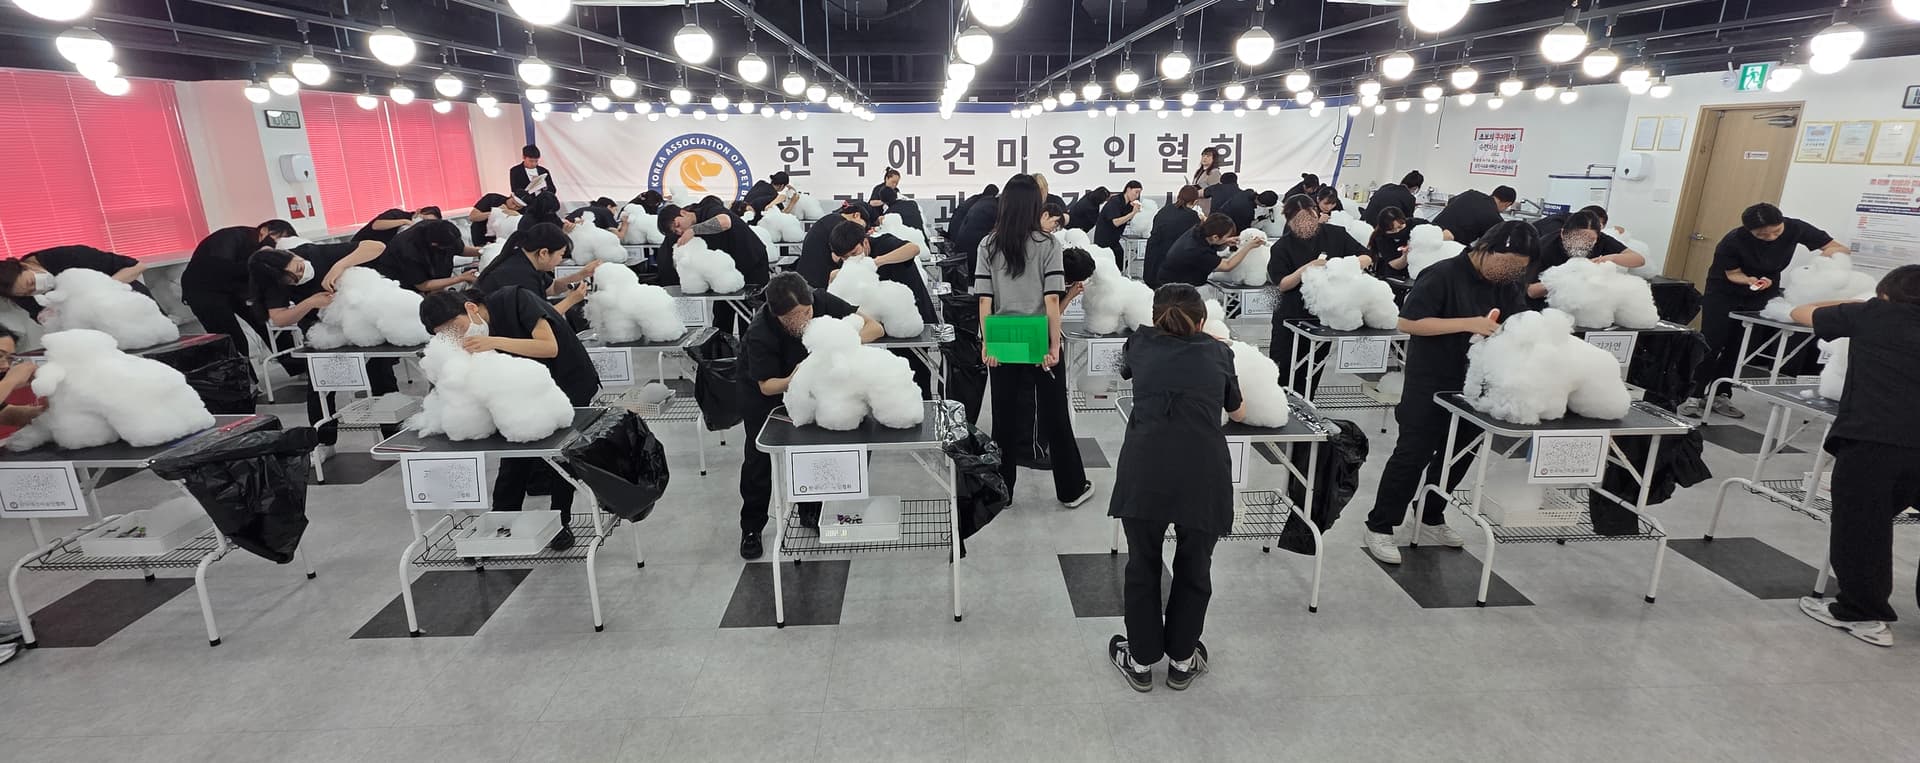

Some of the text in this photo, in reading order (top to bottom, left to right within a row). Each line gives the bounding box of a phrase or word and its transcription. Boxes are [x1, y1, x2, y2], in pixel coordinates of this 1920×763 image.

[652, 137, 750, 187] KOREA ASSOCIATION OF PET
[778, 133, 1242, 177] 한국애견미용인협회
